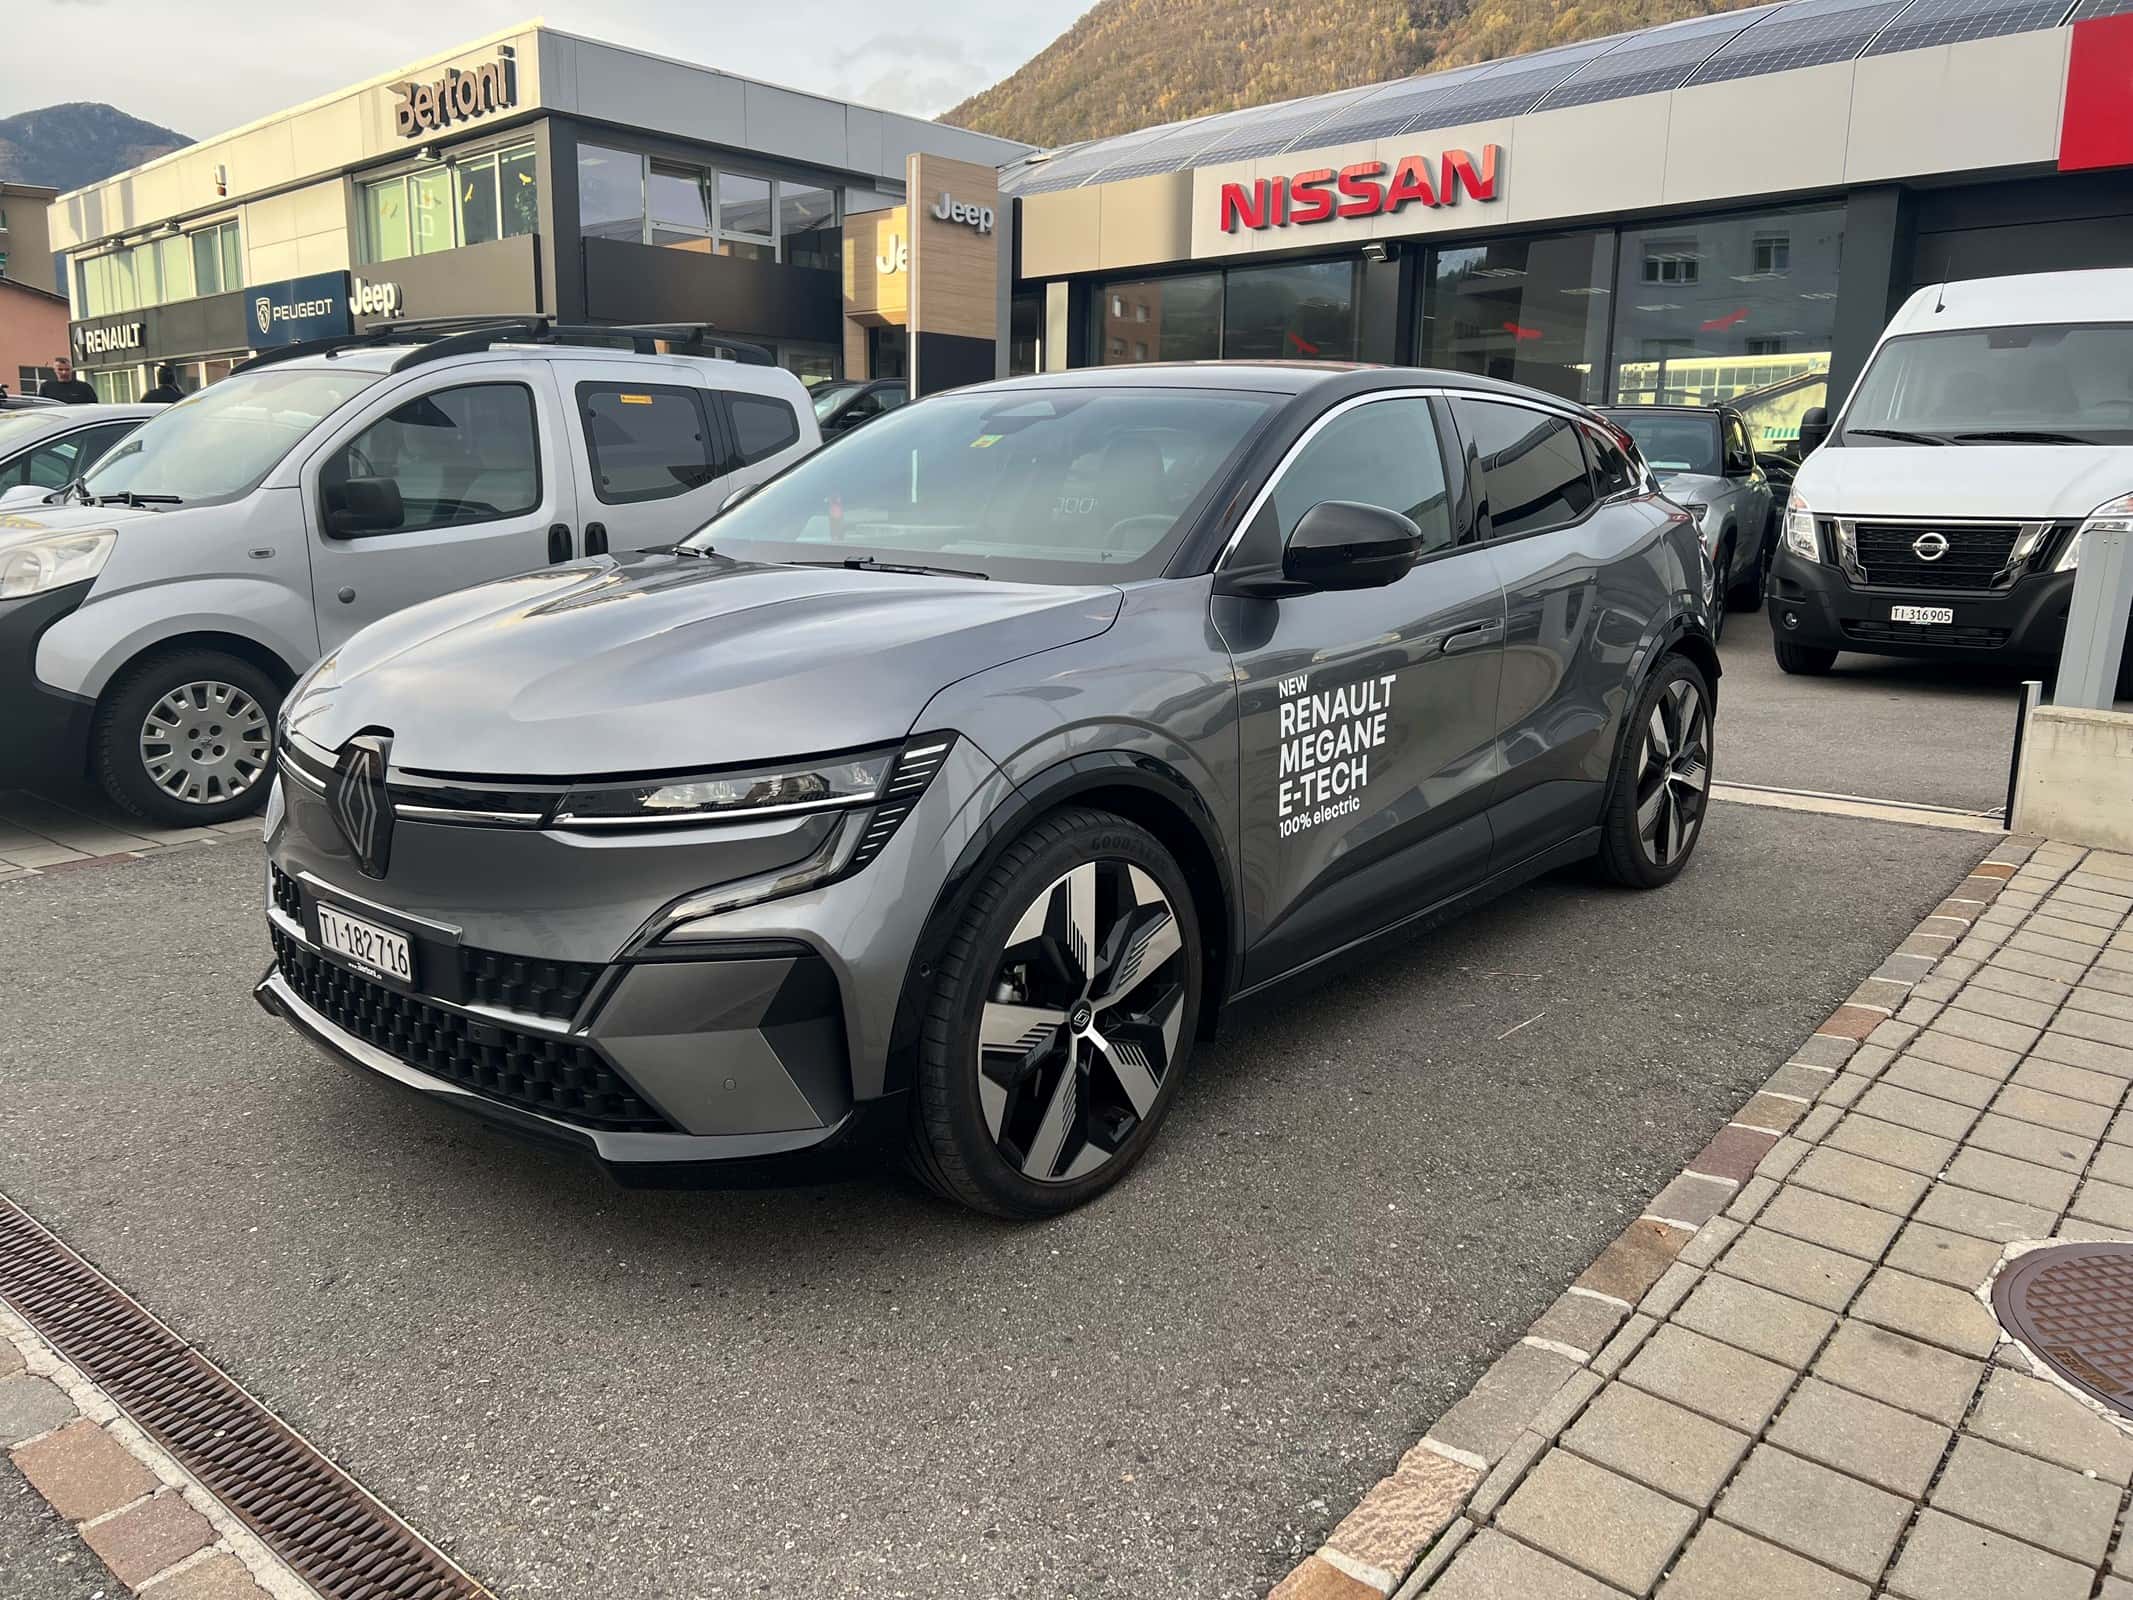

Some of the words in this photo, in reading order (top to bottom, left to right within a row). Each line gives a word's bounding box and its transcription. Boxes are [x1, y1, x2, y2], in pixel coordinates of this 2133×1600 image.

[386, 45, 516, 138] Bertoni
[1220, 143, 1502, 232] NISSAN
[934, 192, 994, 233] Jeep
[273, 298, 334, 322] PEUGEOT
[349, 278, 400, 317] Jeep
[85, 323, 143, 354] RENAULT
[1278, 674, 1308, 698] NEW
[1280, 674, 1397, 738] RENAULT
[1279, 713, 1387, 778] MEGANE
[1279, 754, 1368, 817] E-TECH
[1279, 813, 1312, 839] 100%
[1313, 795, 1361, 825] electric
